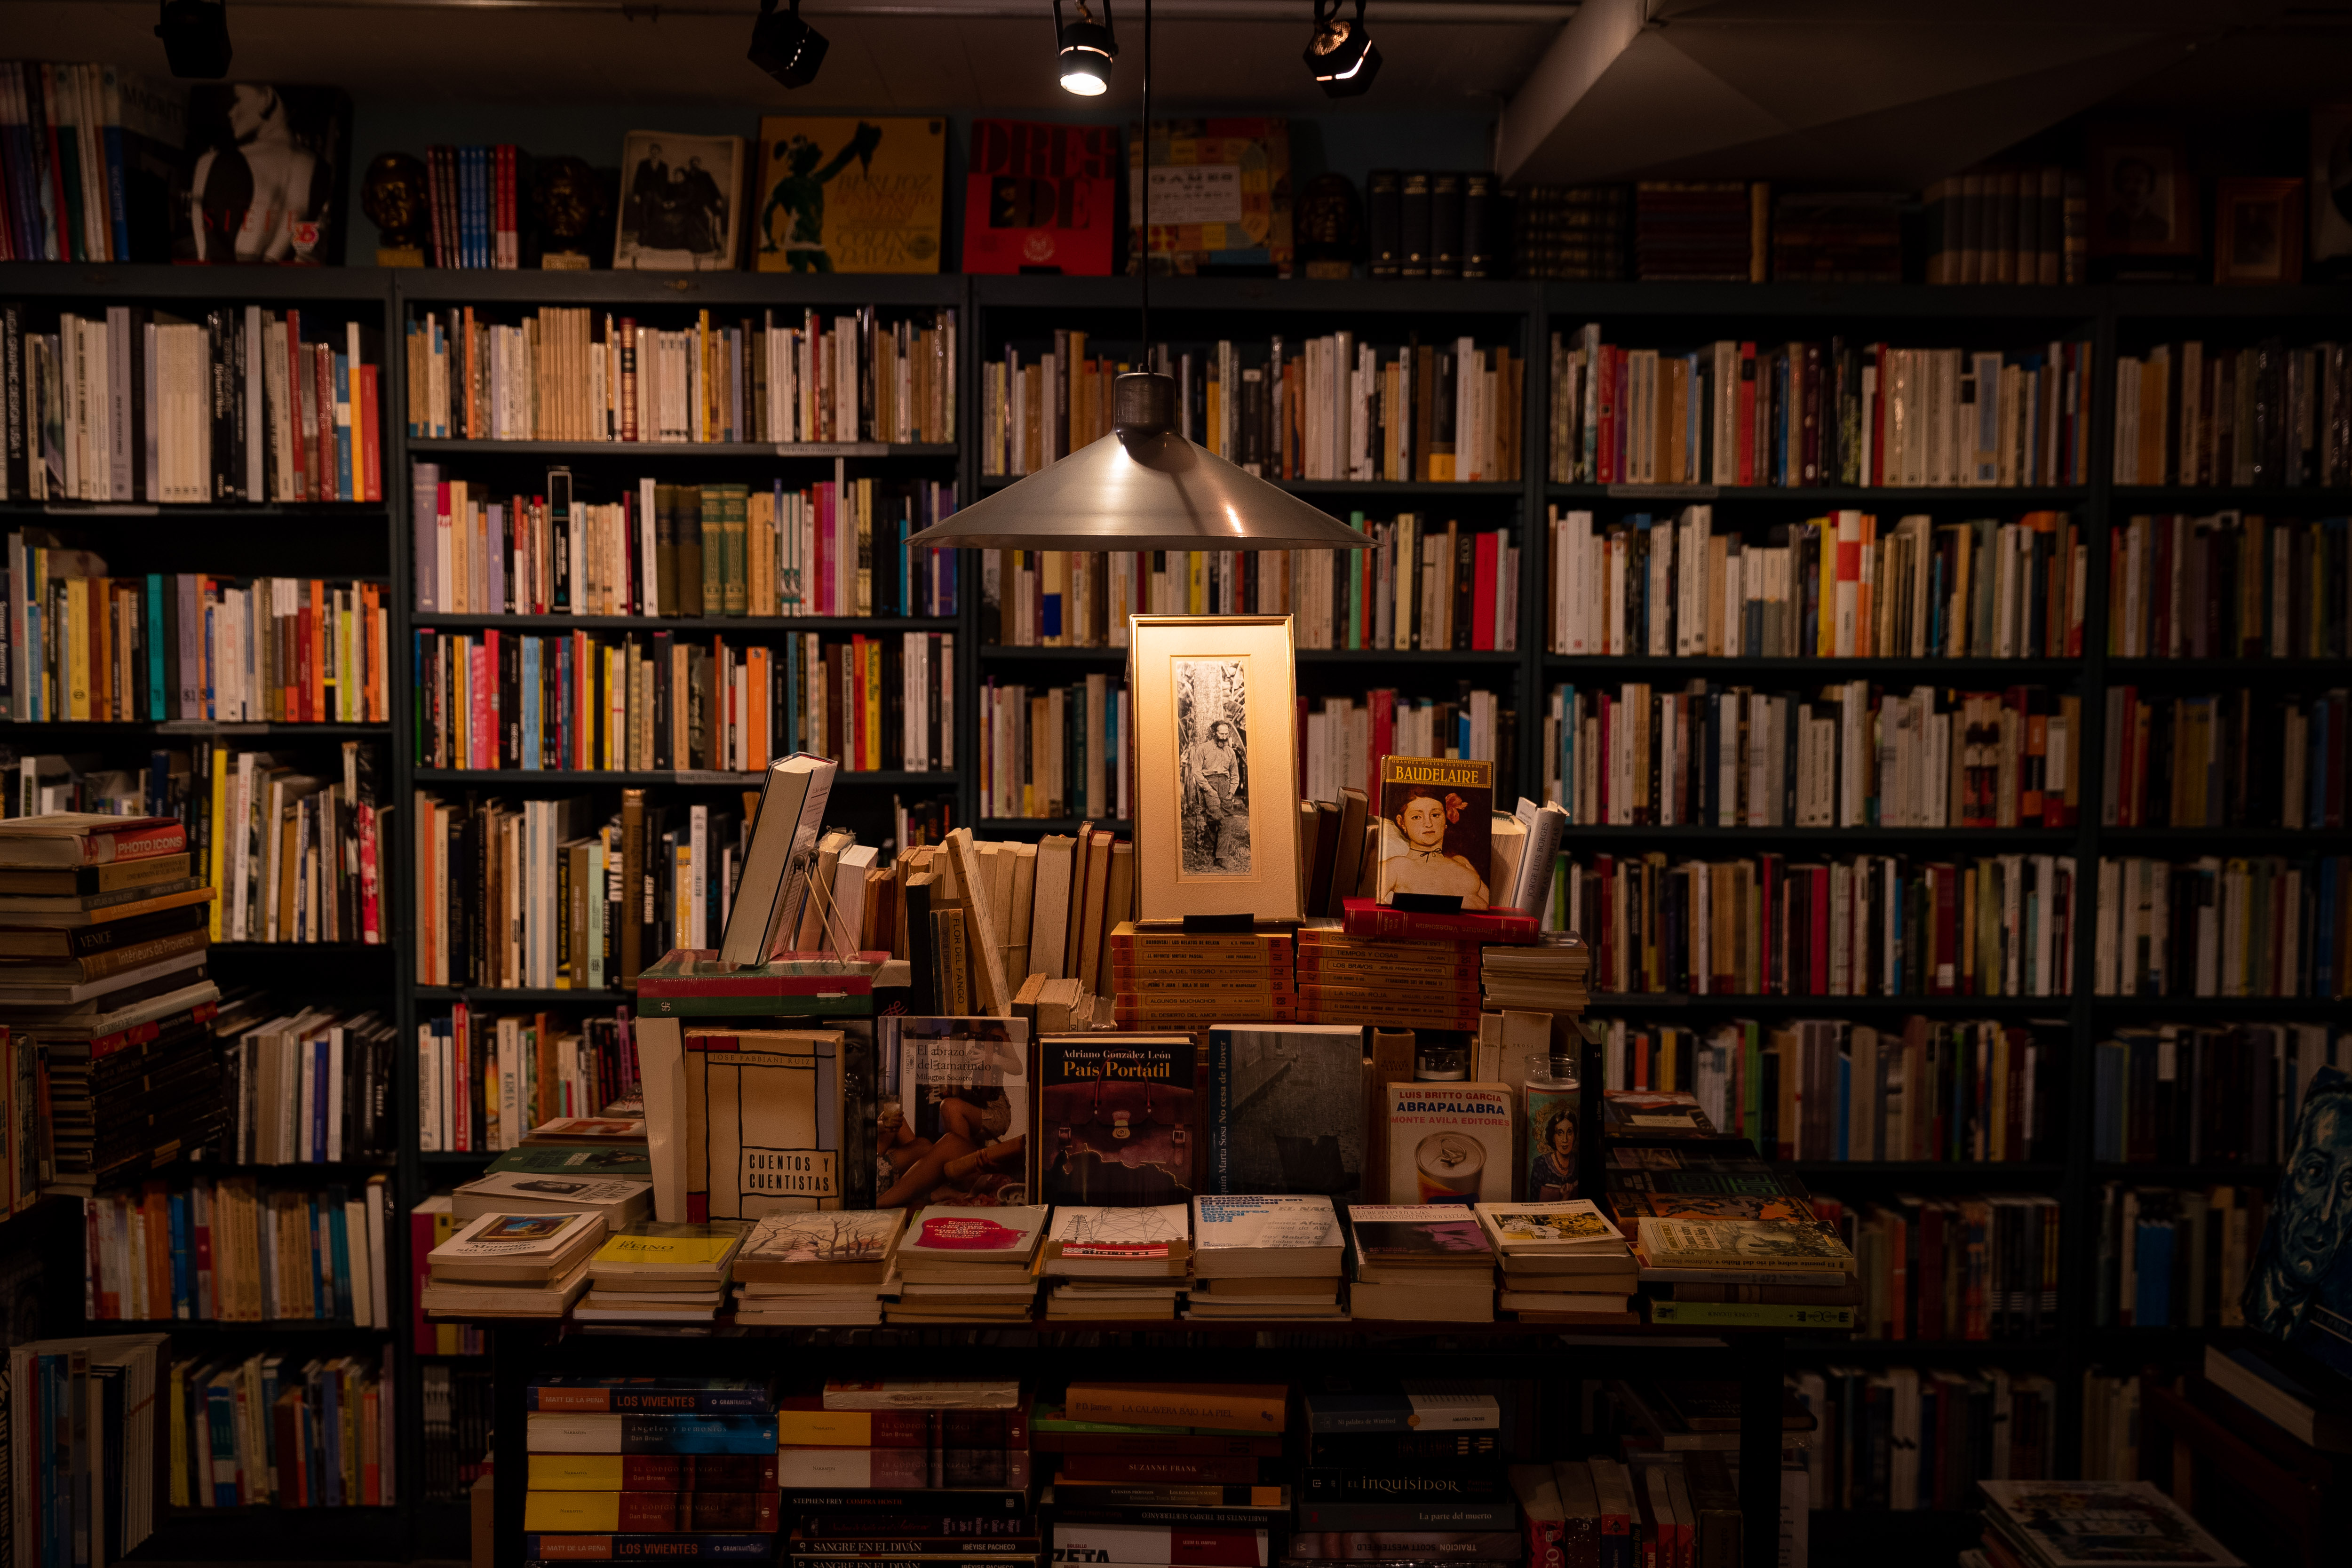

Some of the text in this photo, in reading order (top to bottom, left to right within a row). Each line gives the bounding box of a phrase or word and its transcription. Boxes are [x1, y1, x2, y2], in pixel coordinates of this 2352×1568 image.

[1395, 765, 1479, 784] BAUDELAIRE
[117, 836, 183, 853] PHOTO ICONS
[1527, 821, 1550, 898] JORGE LUIS BORGES
[1539, 828, 1560, 902] OBRAS COMPLETAS
[1415, 922, 1499, 935] Literatura Venezolana
[79, 931, 112, 948] VENICE
[117, 935, 195, 966] Intérieurs de Provence
[956, 968, 965, 1003] FANGO
[917, 1044, 965, 1056] El abrazo
[1063, 1050, 1171, 1059] Adriano González León
[1217, 1041, 1226, 1069] llover
[740, 1054, 783, 1064] FABBIANI
[917, 1059, 992, 1071] del tamarindo
[1063, 1061, 1170, 1078] País Portátil
[1218, 1071, 1226, 1084] de
[1465, 1093, 1502, 1102] GARCIA
[1397, 1102, 1505, 1115] ABRAPALABRA
[1219, 1109, 1226, 1123] No
[1461, 1117, 1510, 1126] EDITORES
[749, 1154, 829, 1172] CUENTOS Y
[749, 1173, 829, 1192] CUENTISTAS
[1220, 1175, 1229, 1195] quín
[617, 1396, 695, 1408] LOS VIVIENTES
[1136, 1405, 1177, 1415] CALAVERA
[1180, 1408, 1199, 1416] BAJO
[1203, 1408, 1213, 1417] LA
[1216, 1409, 1233, 1417] PIEL
[1397, 1438, 1454, 1458] LOS ALAMOS
[1142, 1512, 1189, 1521] SUBTERRÁNEO
[1191, 1513, 1214, 1521] TIEMPO
[1431, 1513, 1450, 1522] parte
[620, 1544, 698, 1555] LOS VIVIENTES
[814, 1540, 922, 1552] SANGRE EN EL DIVÁN
[962, 1542, 986, 1551] IBÉYISE
[1439, 1544, 1476, 1553] TRAICIÓN
[1054, 1549, 1110, 1562] ZETA
